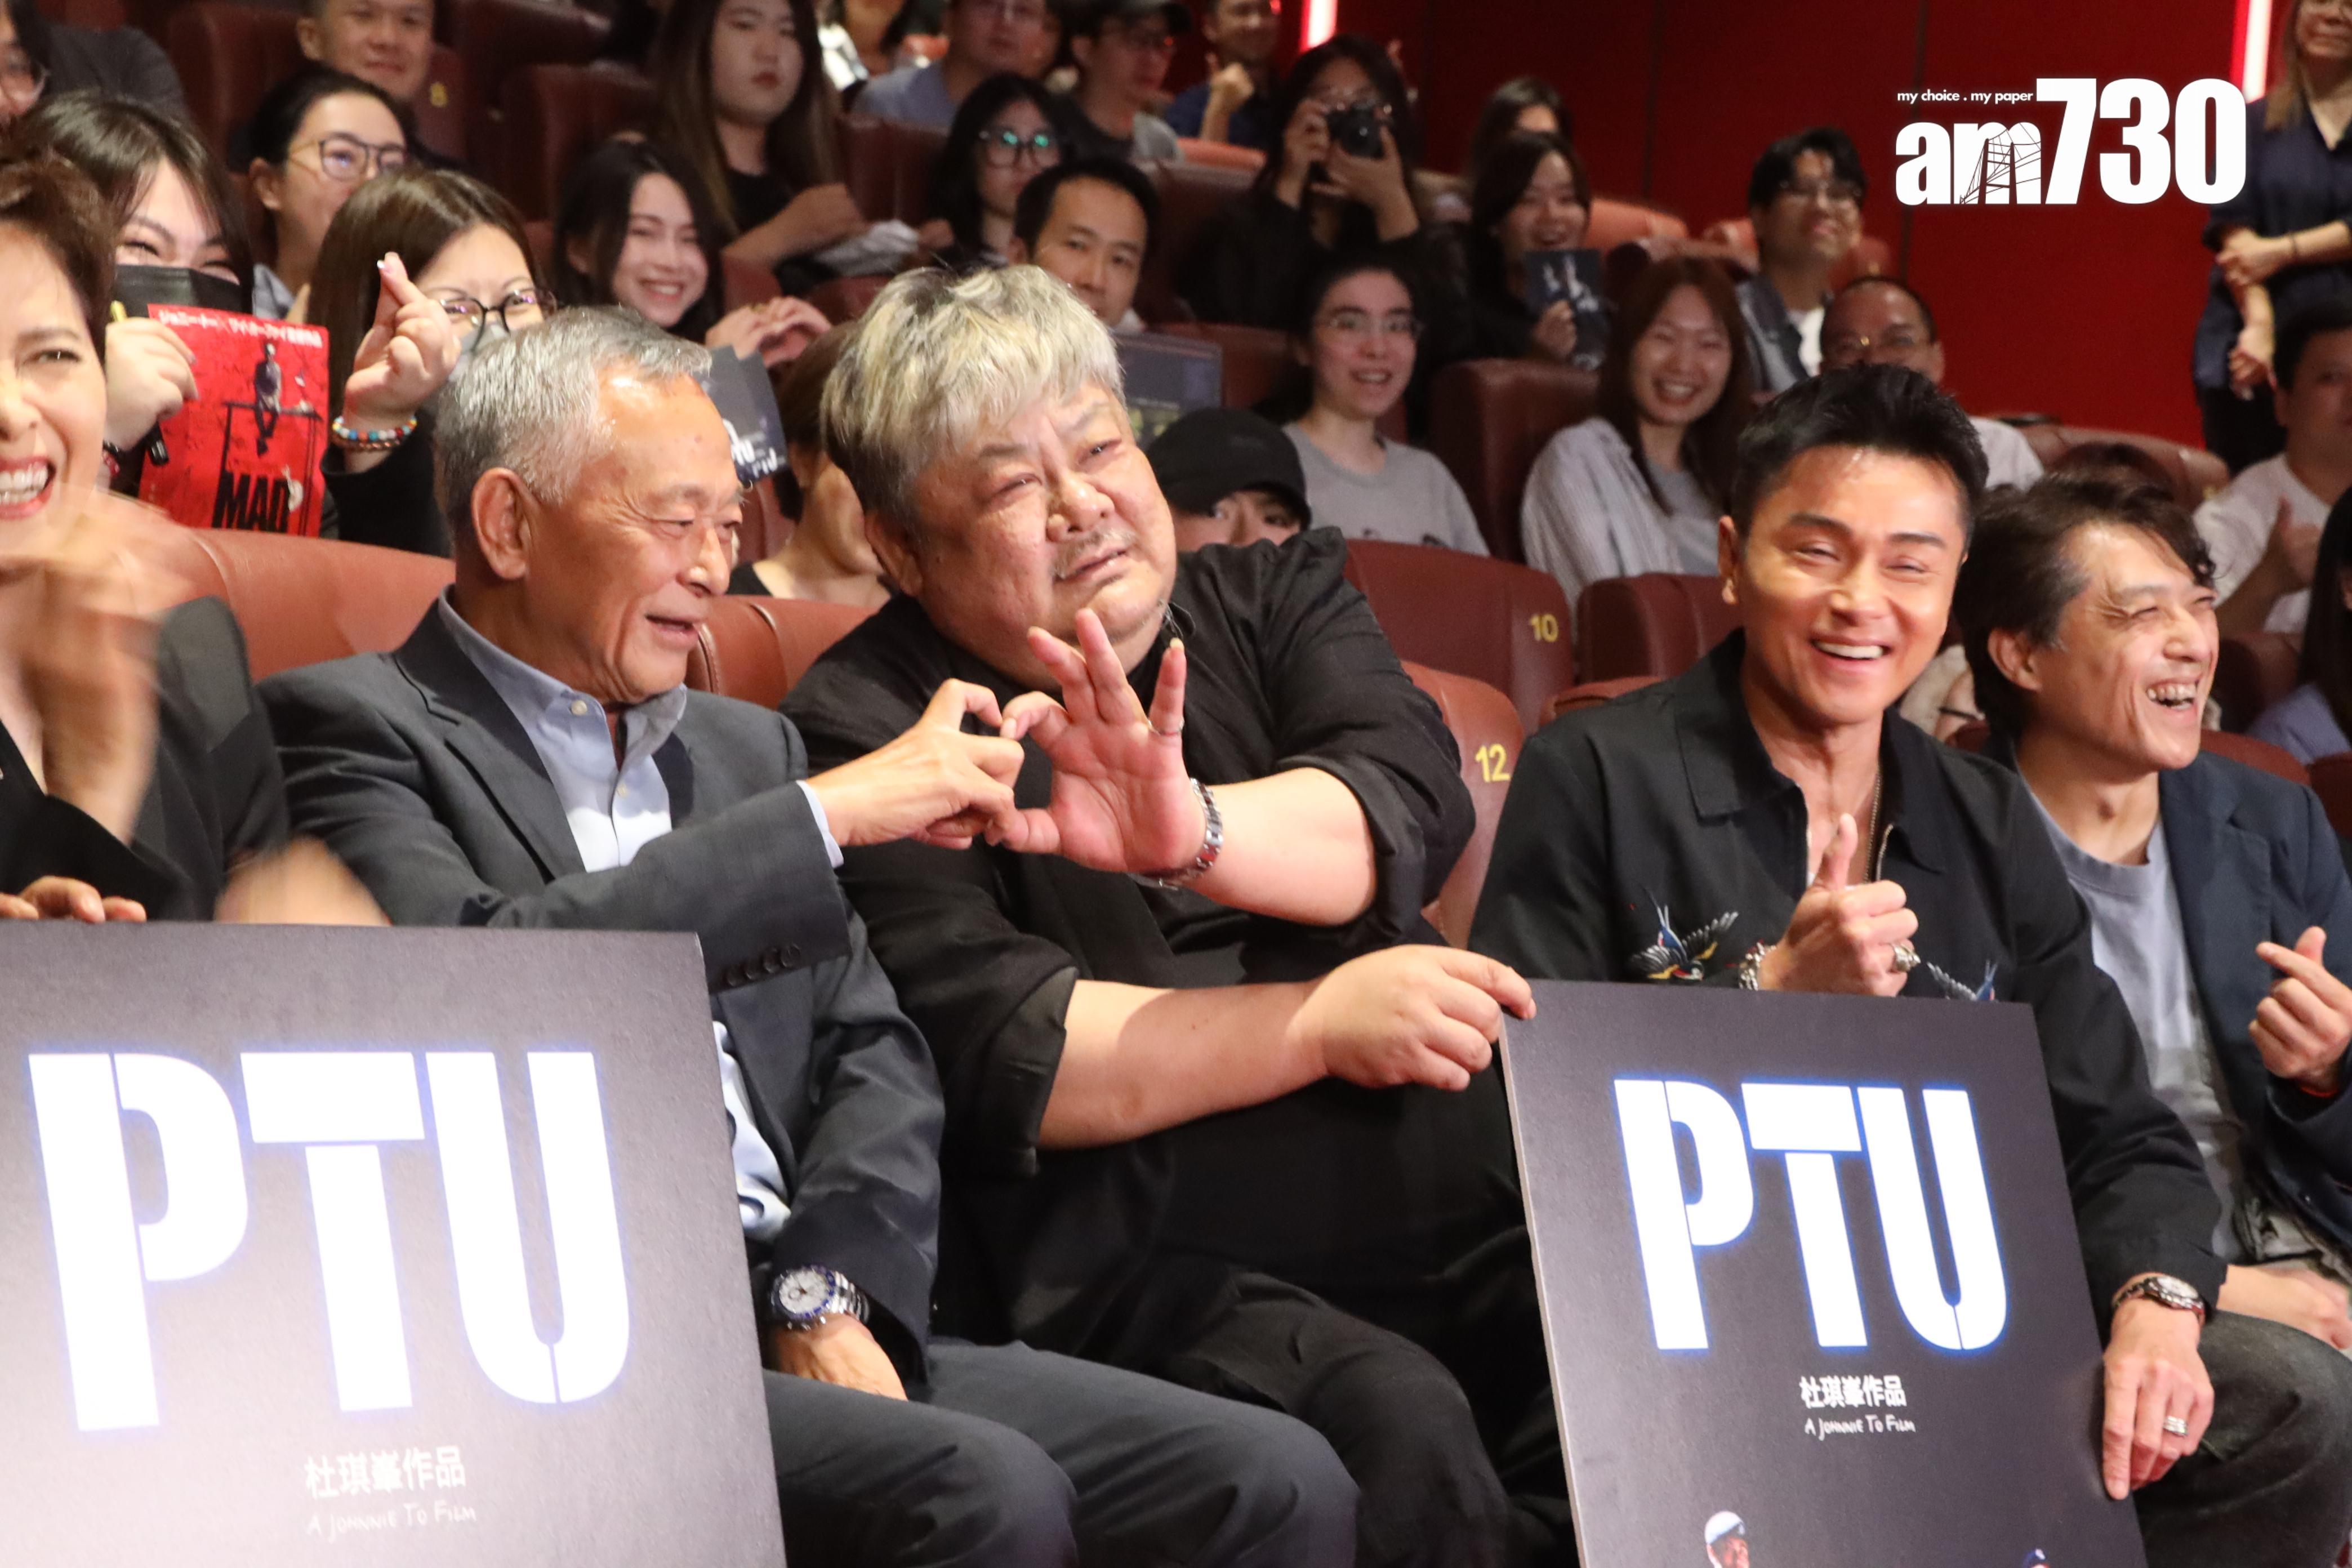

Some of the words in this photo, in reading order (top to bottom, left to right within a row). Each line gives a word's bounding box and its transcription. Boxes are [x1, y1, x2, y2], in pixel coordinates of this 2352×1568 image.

[211, 470, 289, 533] MAD
[1529, 613, 1559, 643] 10
[1475, 743, 1511, 783] 12
[1614, 1079, 2007, 1351] PTU
[28, 1051, 631, 1431] PTU
[1804, 1418, 1816, 1436] A
[306, 1514, 322, 1537] A
